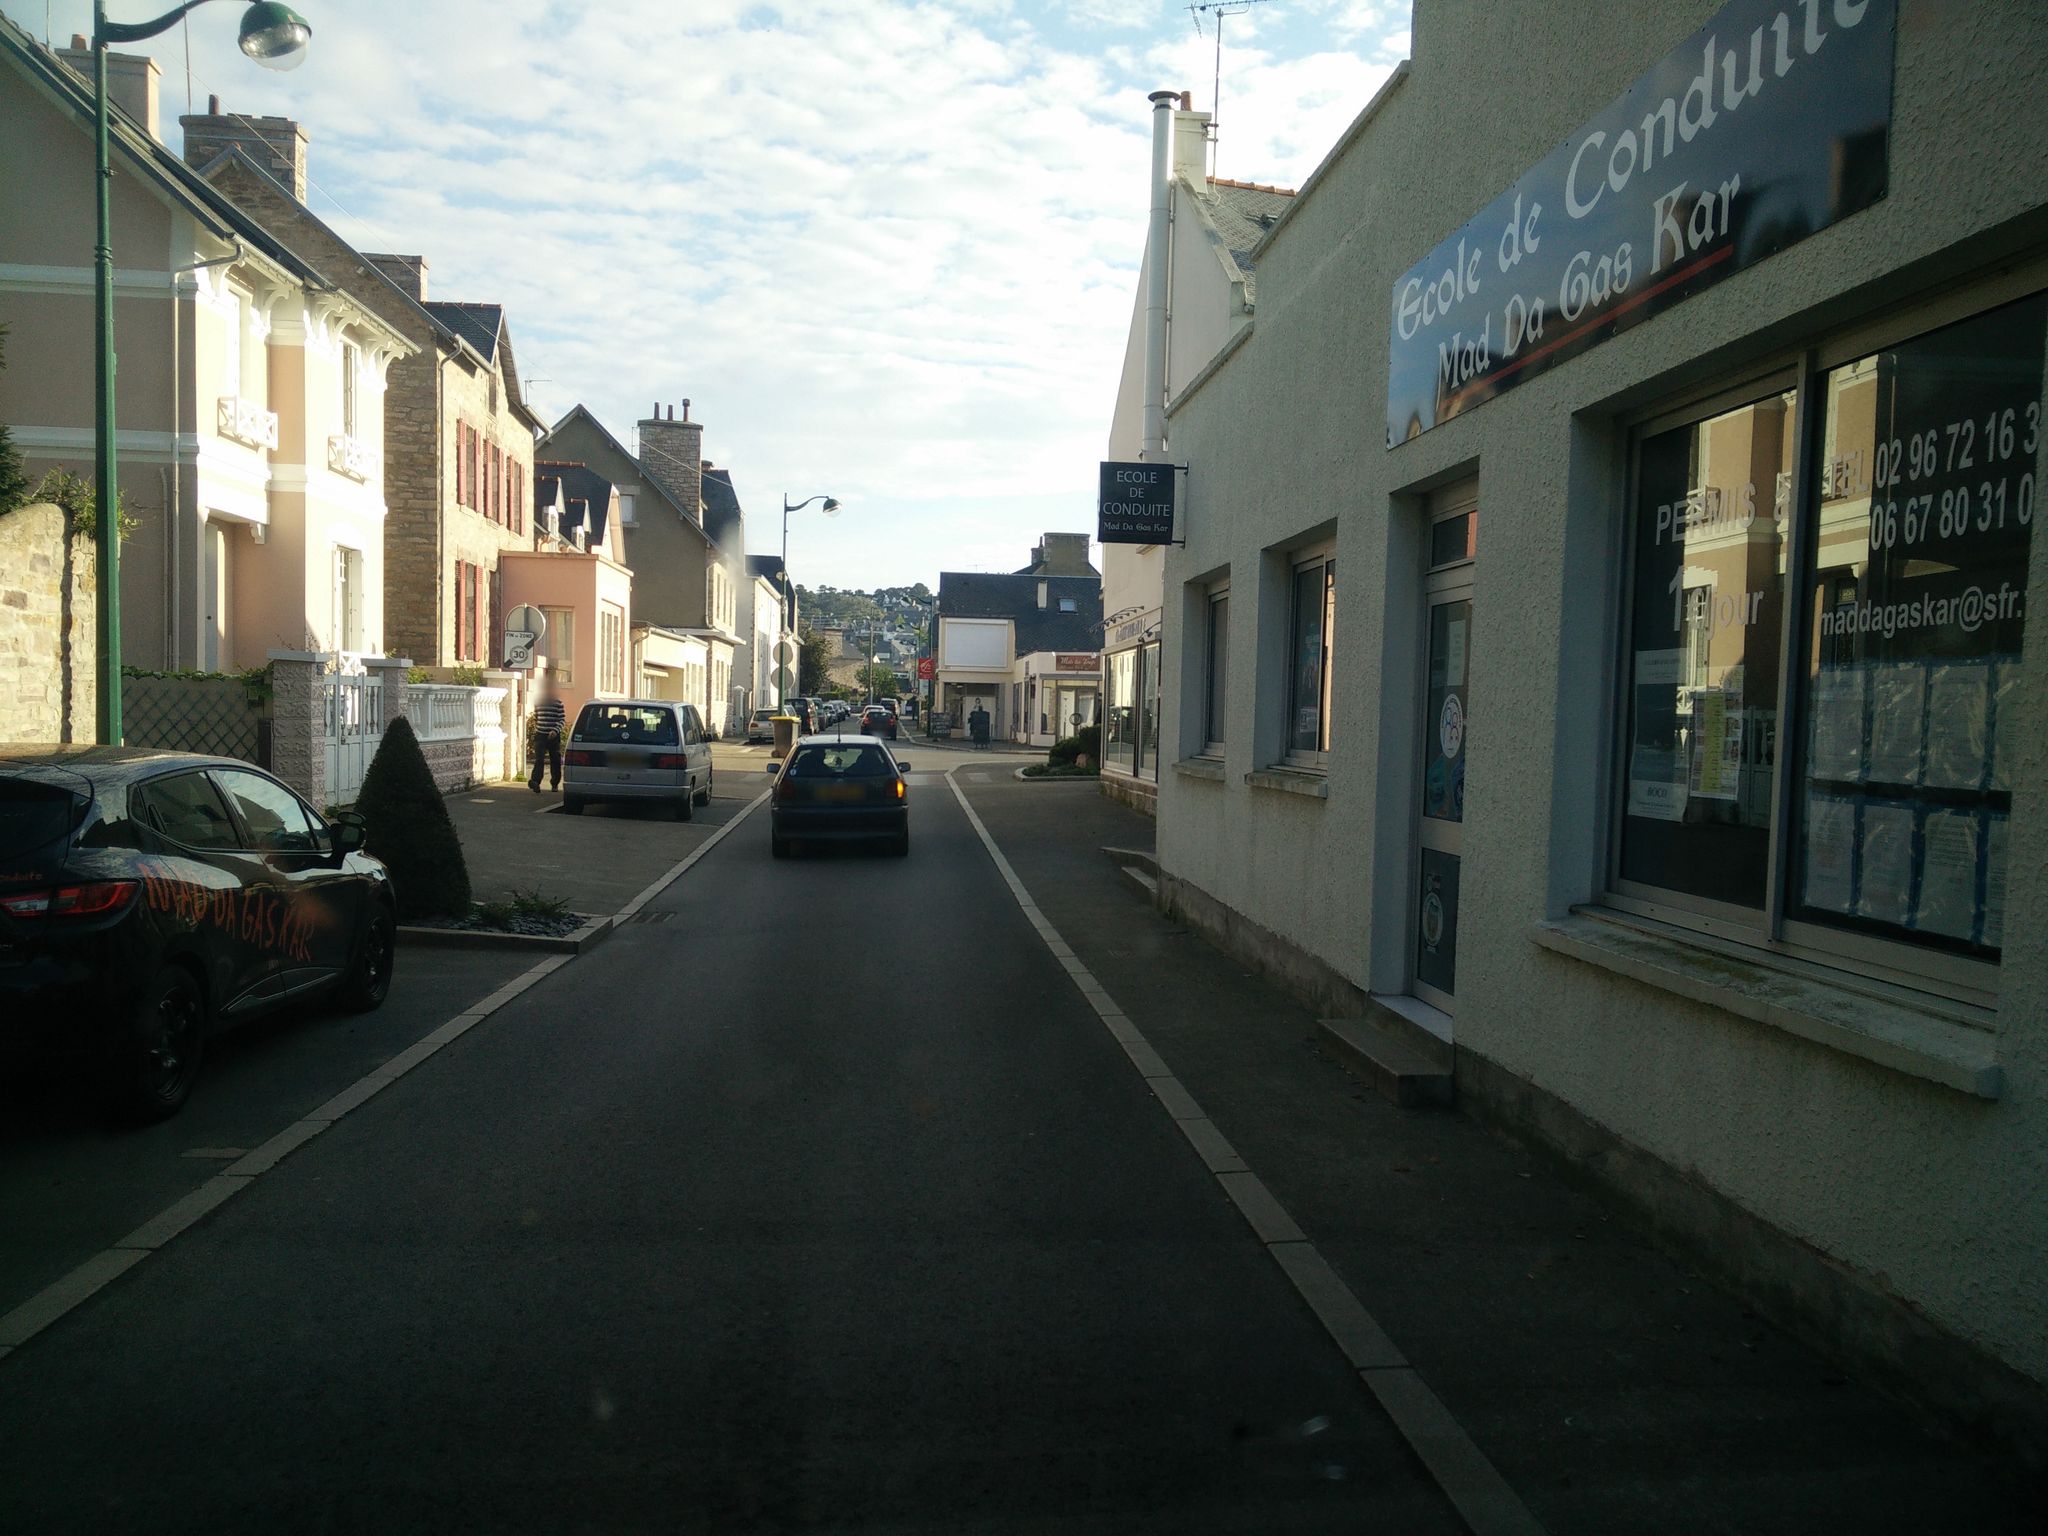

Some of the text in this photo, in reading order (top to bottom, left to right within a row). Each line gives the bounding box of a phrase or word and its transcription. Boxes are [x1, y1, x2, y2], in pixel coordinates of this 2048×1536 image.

[1398, 237, 1481, 340] Ecole
[1500, 193, 1542, 273] de
[1436, 173, 1740, 411] Mad Da Gas Kar
[1875, 438, 1902, 489] 02
[1908, 428, 1938, 480] 96
[1946, 418, 1975, 472] 72
[1985, 407, 2015, 462] 16
[2023, 400, 2041, 454] 3
[1116, 470, 1157, 484] ECOLE
[1129, 487, 1145, 499] DE
[1102, 502, 1170, 517] CONDUITE
[1103, 521, 1120, 532] Mad
[1122, 522, 1134, 531] Da
[1154, 523, 1168, 532] Kar
[1655, 483, 1757, 546] PERMIS
[1870, 472, 2034, 551] 06 67 80 31 0
[513, 650, 525, 658] 30
